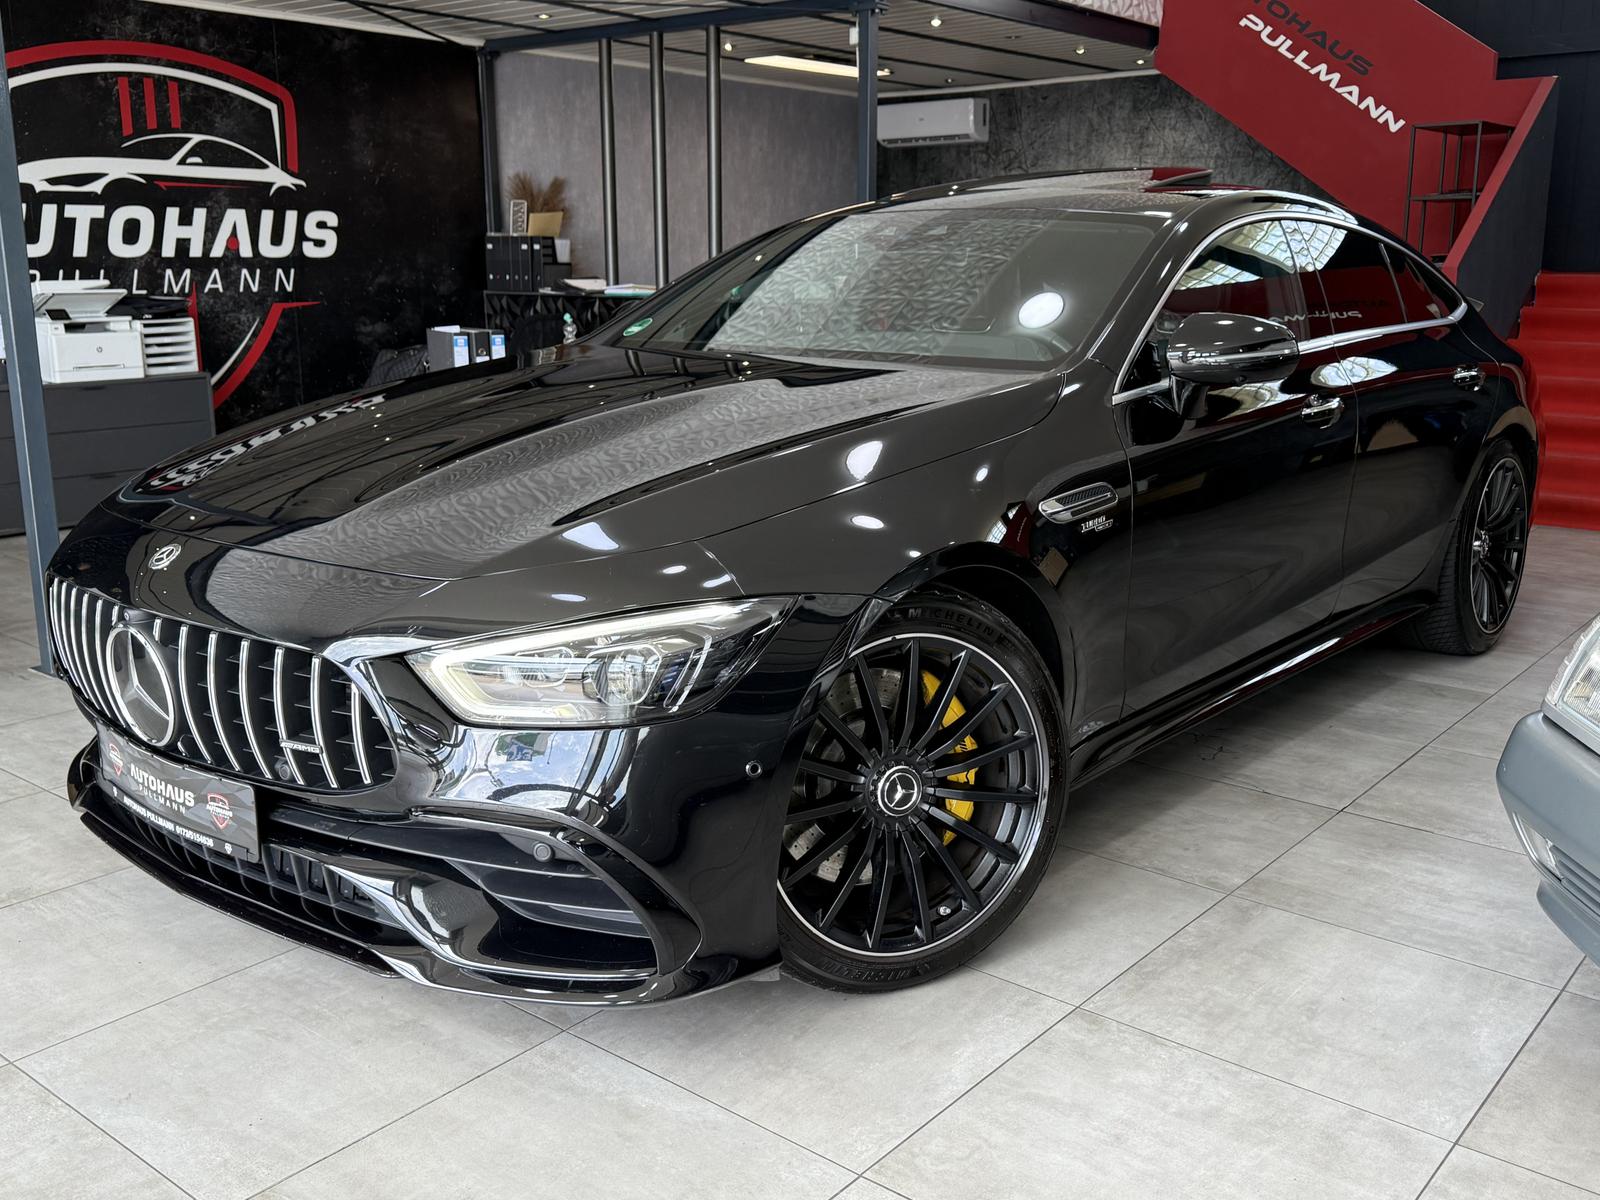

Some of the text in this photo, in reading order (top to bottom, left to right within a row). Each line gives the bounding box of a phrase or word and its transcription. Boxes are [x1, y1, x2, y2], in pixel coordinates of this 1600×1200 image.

[1253, 0, 1374, 76] OHAUS
[1239, 14, 1406, 133] PULLMANN
[21, 203, 339, 258] UTOHAUS
[908, 607, 995, 636] MICHELIN
[292, 743, 320, 754] AMG
[130, 763, 195, 807] AUTOHAUS
[139, 783, 186, 814] PULLMANN
